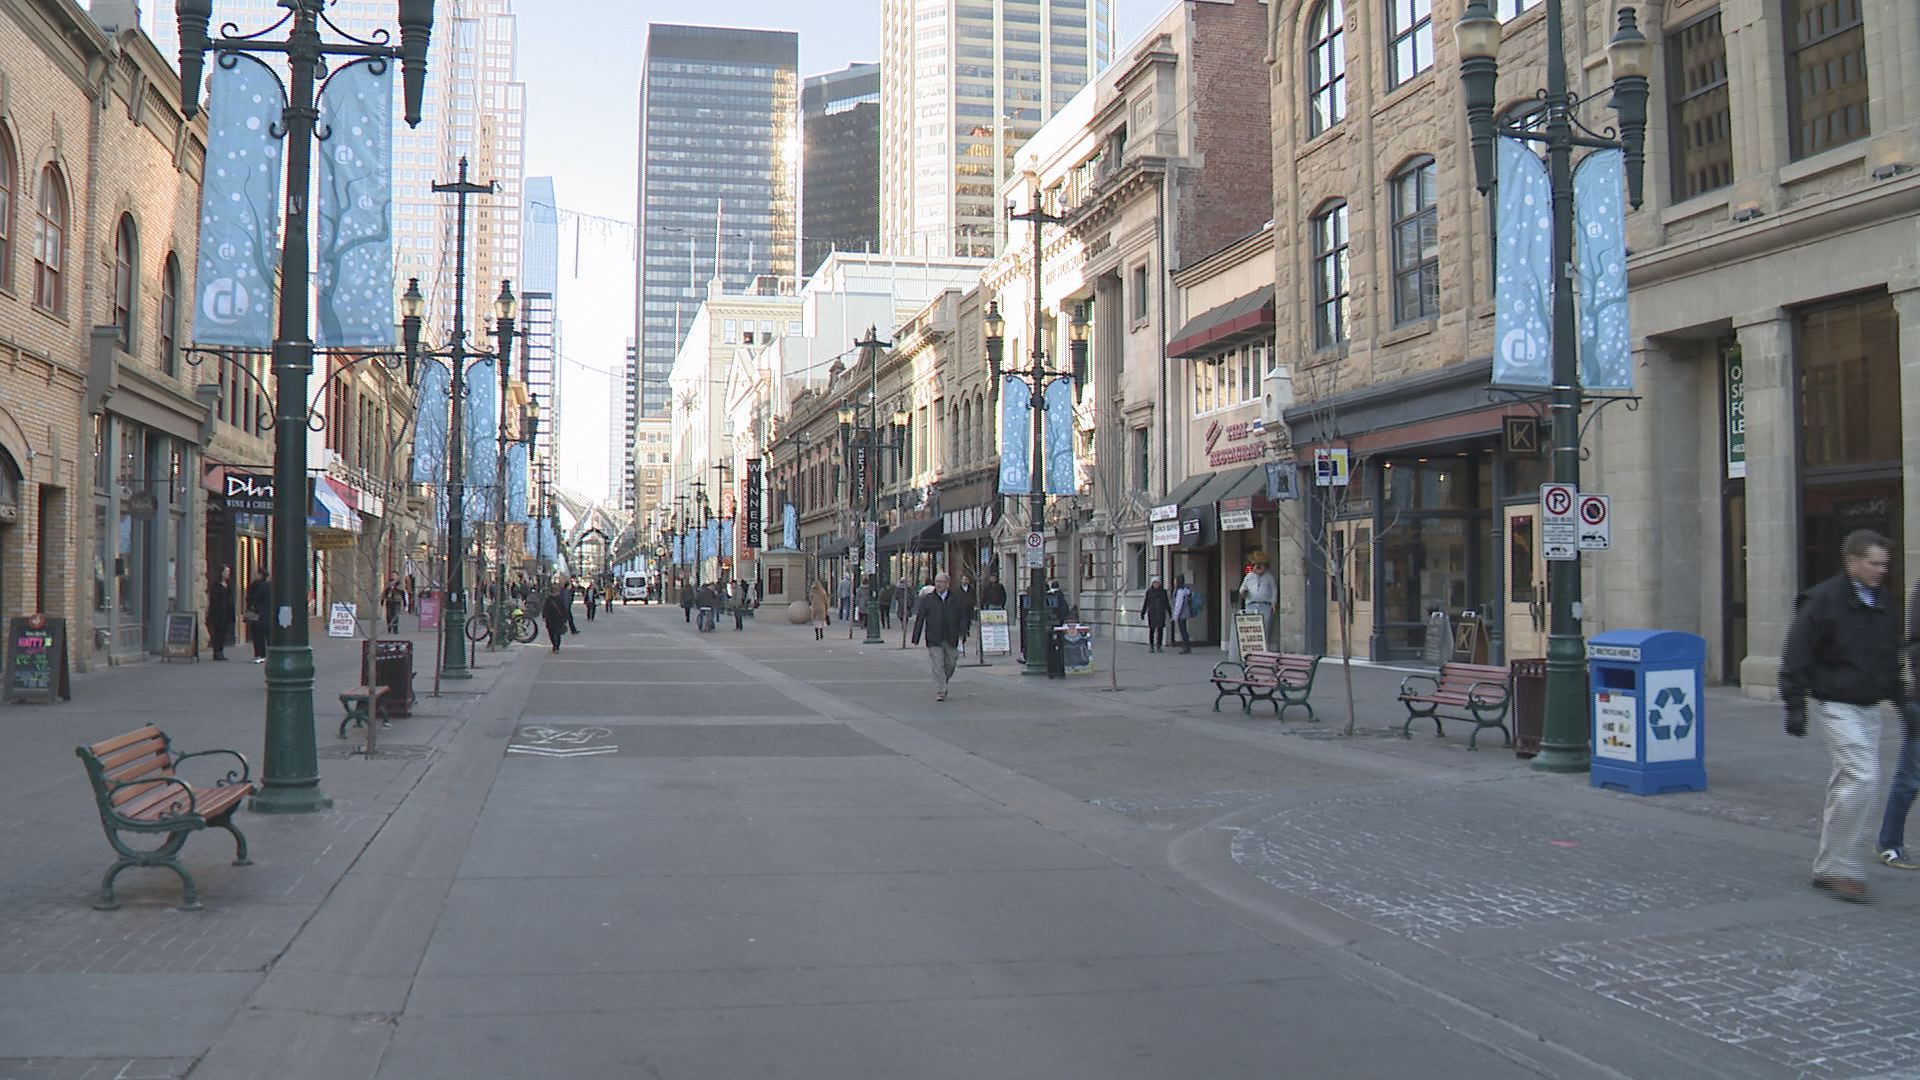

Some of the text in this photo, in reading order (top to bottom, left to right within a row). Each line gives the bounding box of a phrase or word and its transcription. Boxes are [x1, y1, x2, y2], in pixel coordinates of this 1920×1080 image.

[1091, 231, 1111, 258] BANK
[226, 500, 244, 508] WINE
[749, 464, 760, 543] WINNERS
[1595, 648, 1616, 656] RECYCLE
